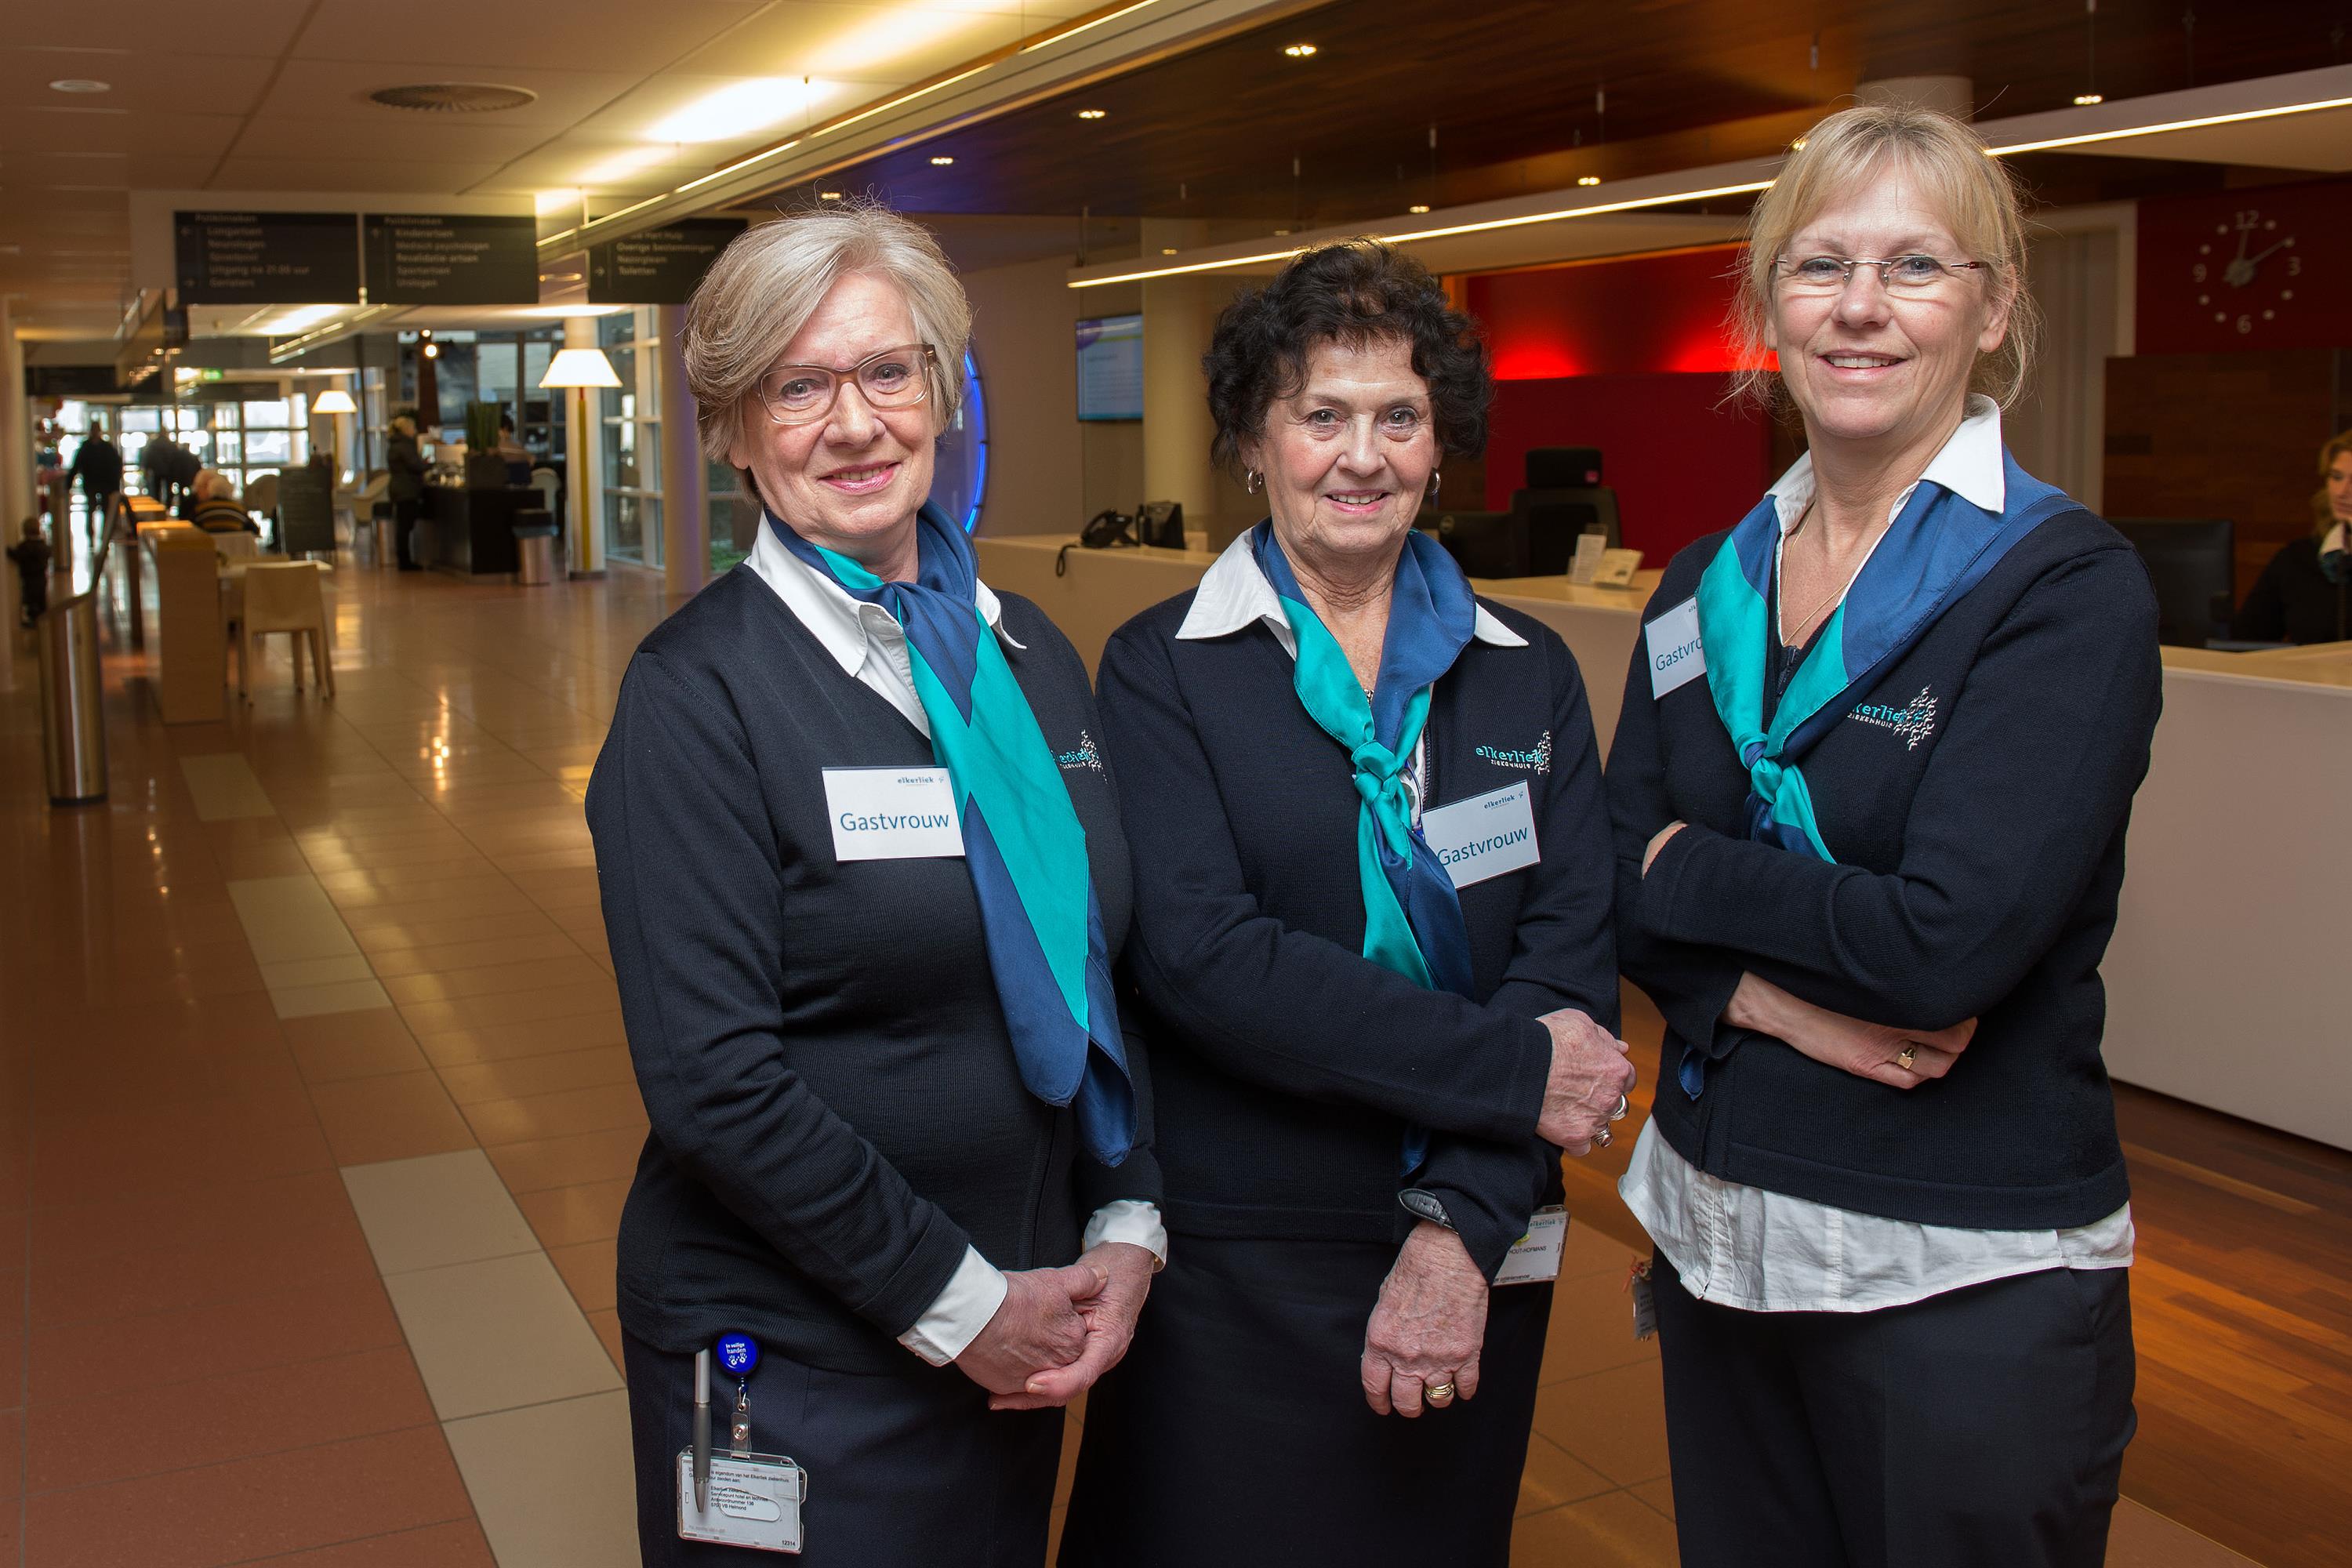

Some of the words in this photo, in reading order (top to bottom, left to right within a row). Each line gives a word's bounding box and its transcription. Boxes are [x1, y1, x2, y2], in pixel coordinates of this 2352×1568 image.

[2234, 210, 2259, 230] 12
[2191, 263, 2208, 284] 9
[2288, 256, 2303, 277] 3
[2236, 314, 2253, 335] 6
[1475, 745, 1543, 764] elkerliek
[1483, 794, 1515, 809] elkerliek
[840, 812, 949, 832] Gastvrouw
[1437, 826, 1528, 867] Gastvrouw
